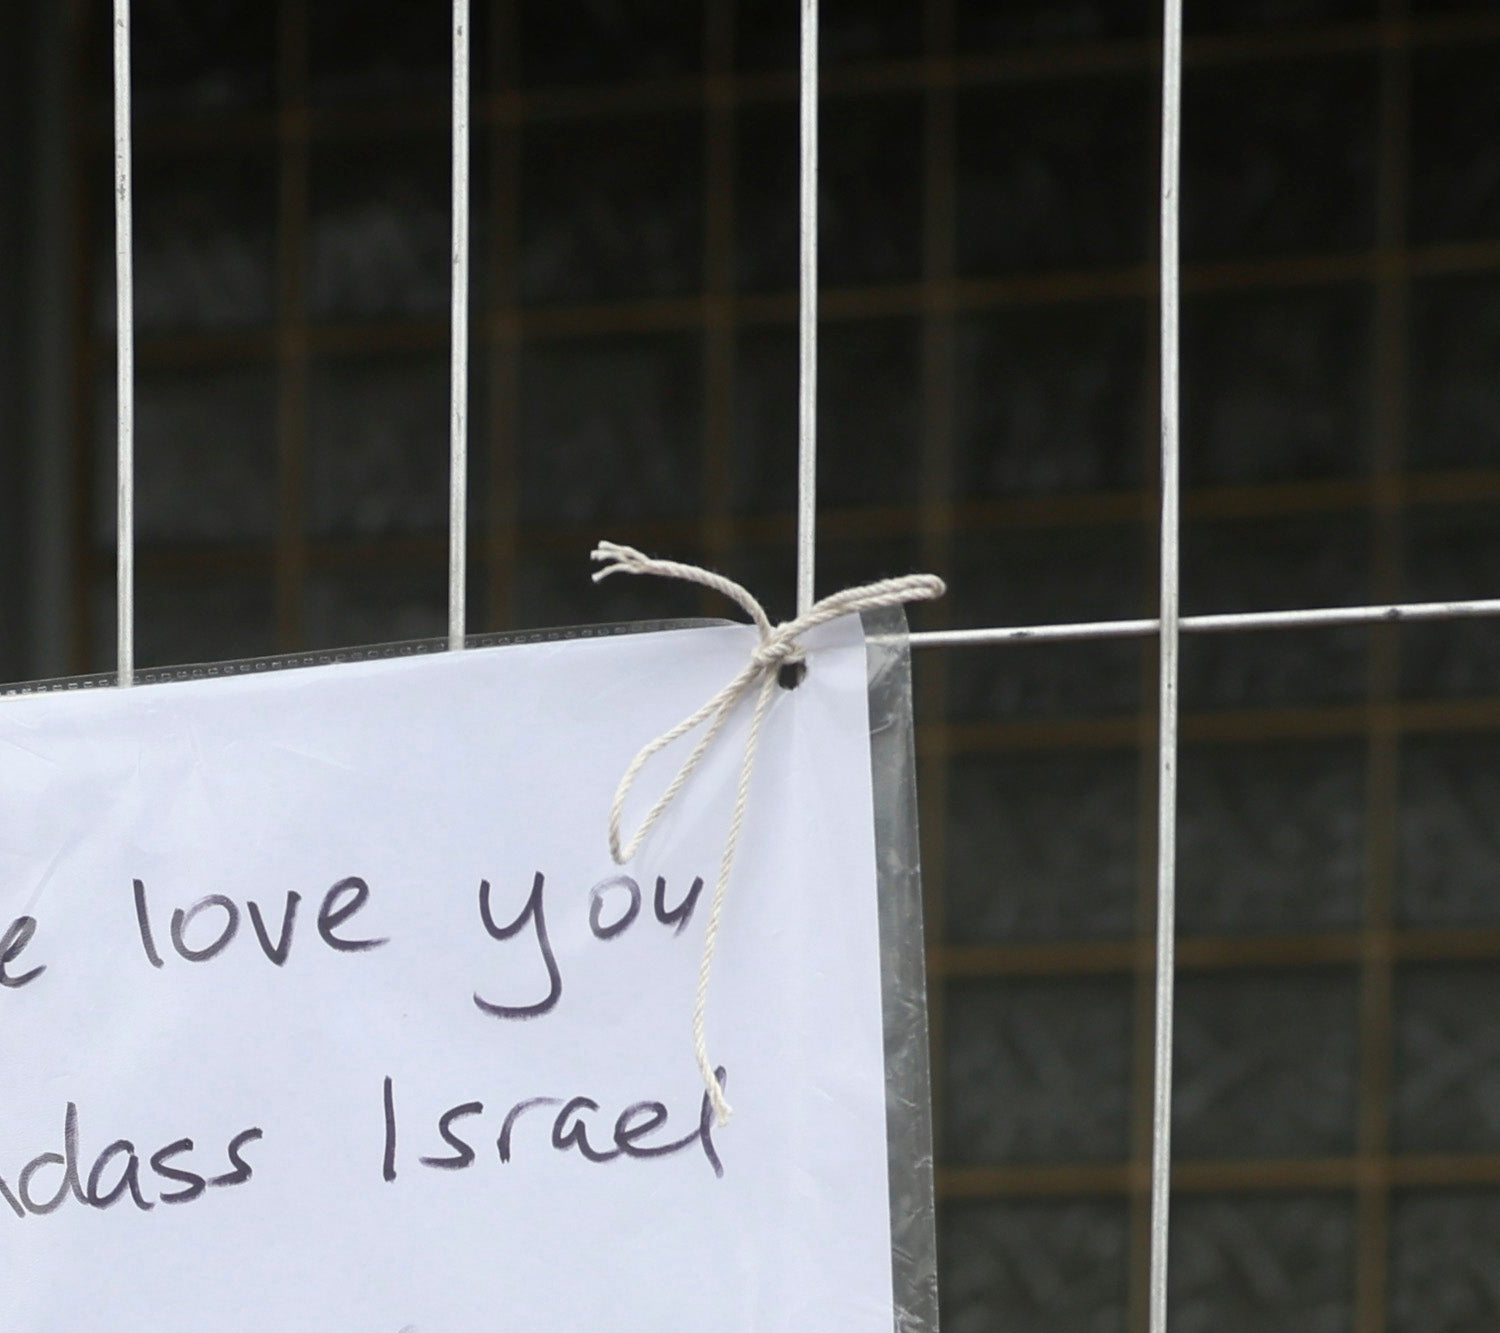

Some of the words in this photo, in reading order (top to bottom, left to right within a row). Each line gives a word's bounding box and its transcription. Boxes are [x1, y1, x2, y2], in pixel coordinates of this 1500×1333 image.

[132, 875, 391, 969] love
[473, 871, 705, 1020] you
[382, 1065, 728, 1182] Israel
